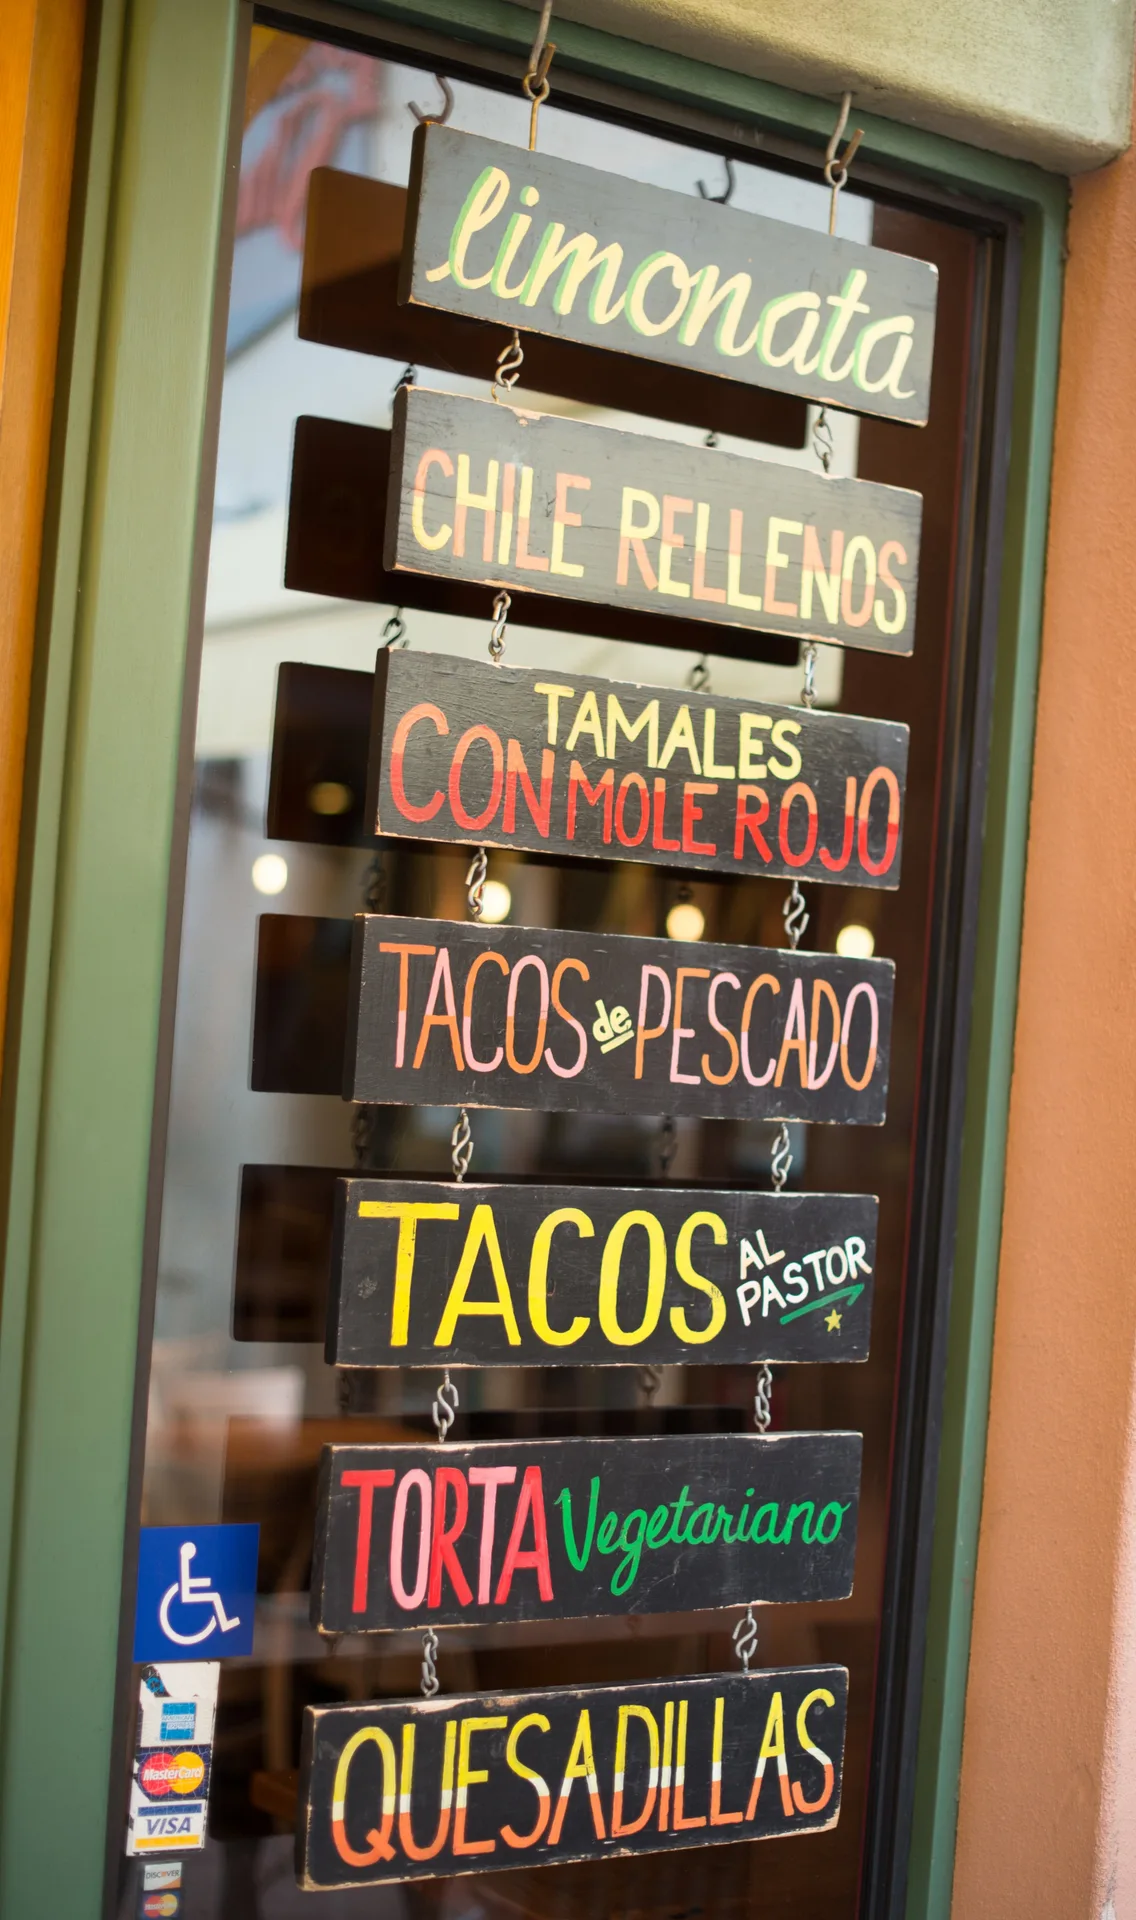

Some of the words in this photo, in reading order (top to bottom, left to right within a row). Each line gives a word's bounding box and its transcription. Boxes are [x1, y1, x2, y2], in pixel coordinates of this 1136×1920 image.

[426, 166, 916, 398] limonata
[412, 449, 591, 578] CHILE
[616, 486, 907, 635] RELLENOS
[389, 703, 555, 838] CON
[566, 760, 718, 856] MOLE
[733, 766, 900, 876] ROJO
[534, 682, 802, 781] TAMALES
[379, 942, 590, 1079] TACOS
[592, 998, 633, 1043] de
[634, 964, 879, 1091] PESCADO
[358, 1201, 728, 1347] TACOS
[736, 1236, 872, 1327] PASTOR
[740, 1229, 786, 1280] AL
[340, 1466, 554, 1614] TORTA
[554, 1476, 852, 1596] Vegetariano
[143, 1766, 204, 1781] MasterCard
[146, 1817, 192, 1835] VISA
[332, 1688, 836, 1867] QUESADILLAS
[145, 1870, 180, 1879] DISCOVER
